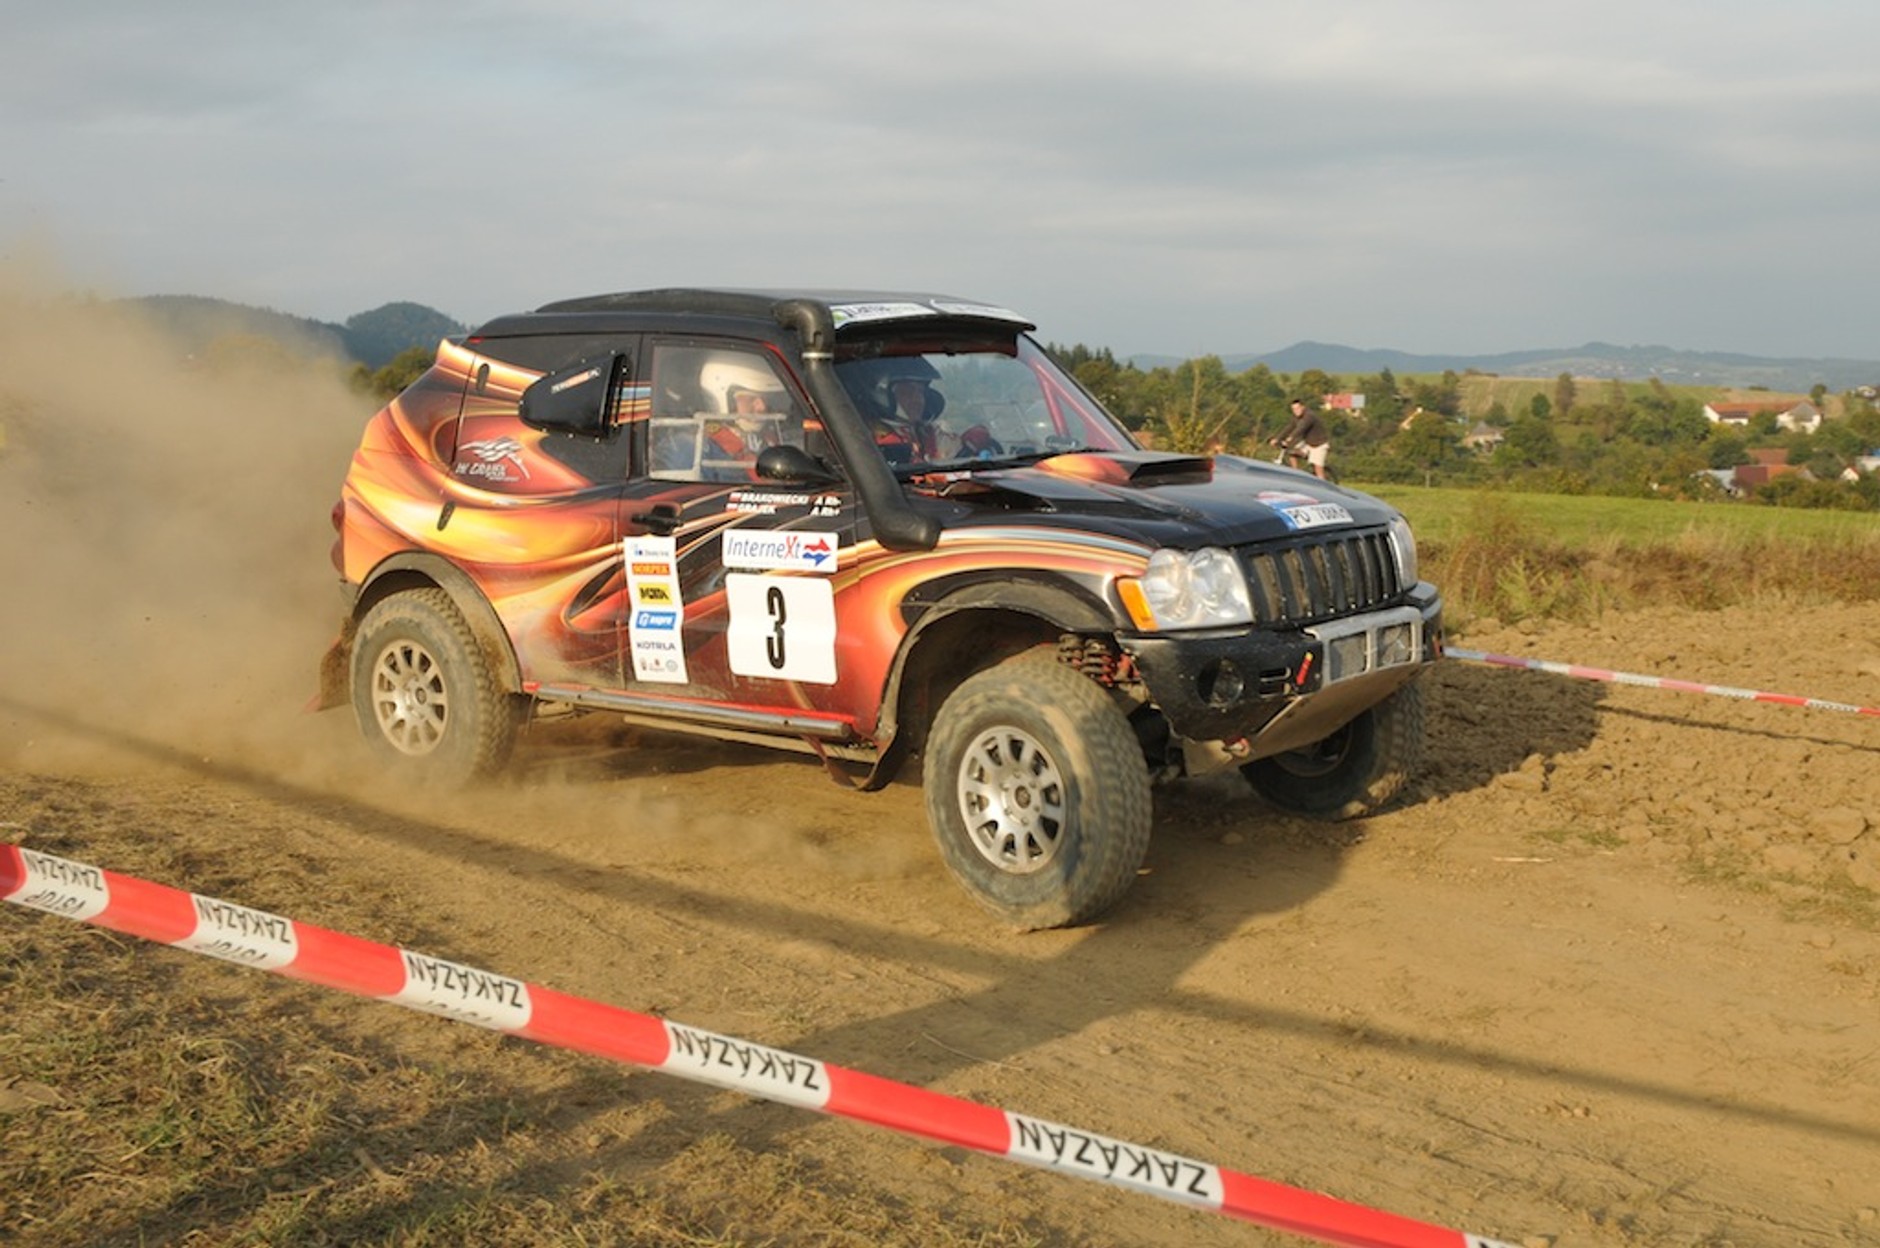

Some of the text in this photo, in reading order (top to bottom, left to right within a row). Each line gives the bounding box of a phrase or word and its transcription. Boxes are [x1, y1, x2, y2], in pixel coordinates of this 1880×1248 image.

[727, 535, 801, 560] InterneXt
[636, 641, 677, 651] KOTRLA
[766, 586, 787, 669] 3
[196, 897, 292, 945] ZAKÁZÁN
[406, 954, 524, 1009] ZAKÁZÁN
[670, 1026, 820, 1092] ZAKÁZÁN
[1015, 1117, 1210, 1198] ZAKÁZÁN
